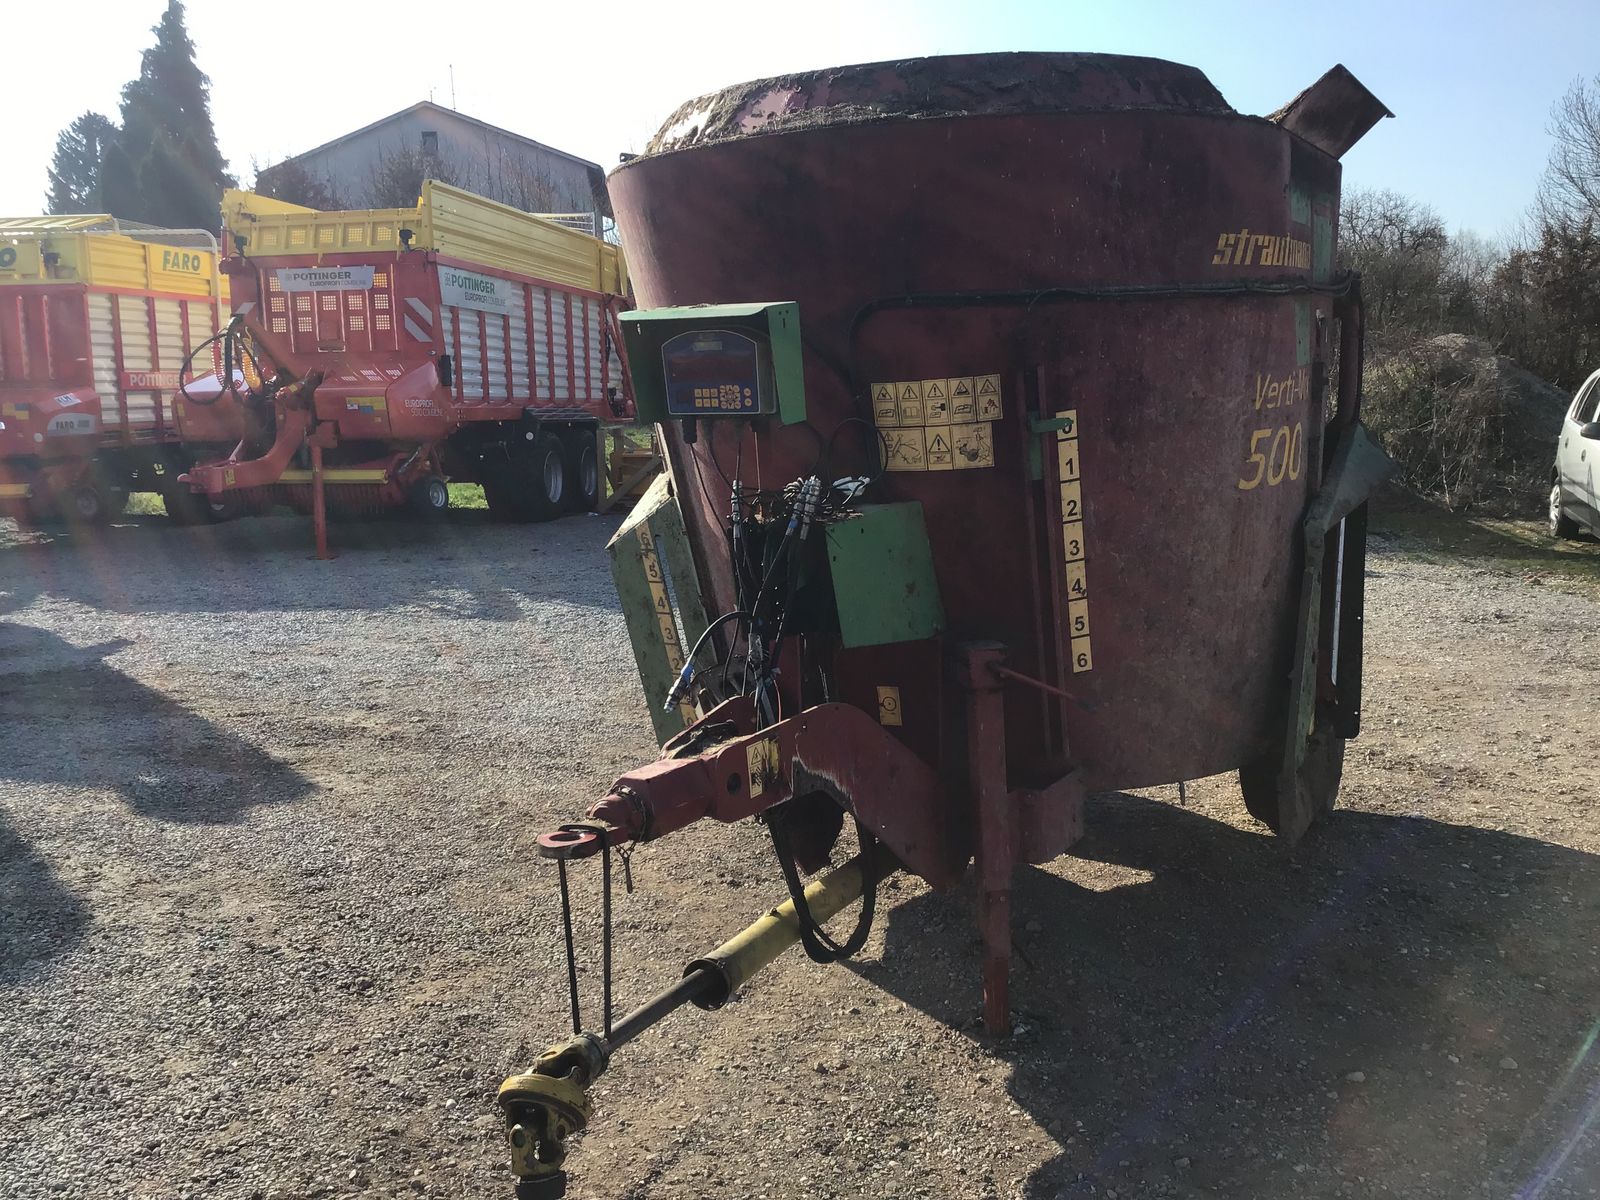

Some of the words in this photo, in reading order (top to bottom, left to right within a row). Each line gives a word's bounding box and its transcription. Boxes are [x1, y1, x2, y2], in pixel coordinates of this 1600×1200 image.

[162, 250, 201, 272] FARO
[1238, 421, 1302, 490] 500
[1065, 457, 1074, 475] 1
[1066, 499, 1078, 517] 2
[1069, 539, 1080, 556] 3
[649, 561, 658, 578] 5
[1071, 577, 1083, 594] 4
[657, 596, 666, 609] 4
[1074, 615, 1085, 632] 5
[664, 627, 674, 640] 3
[672, 657, 681, 671] 2
[1076, 652, 1088, 668] 6
